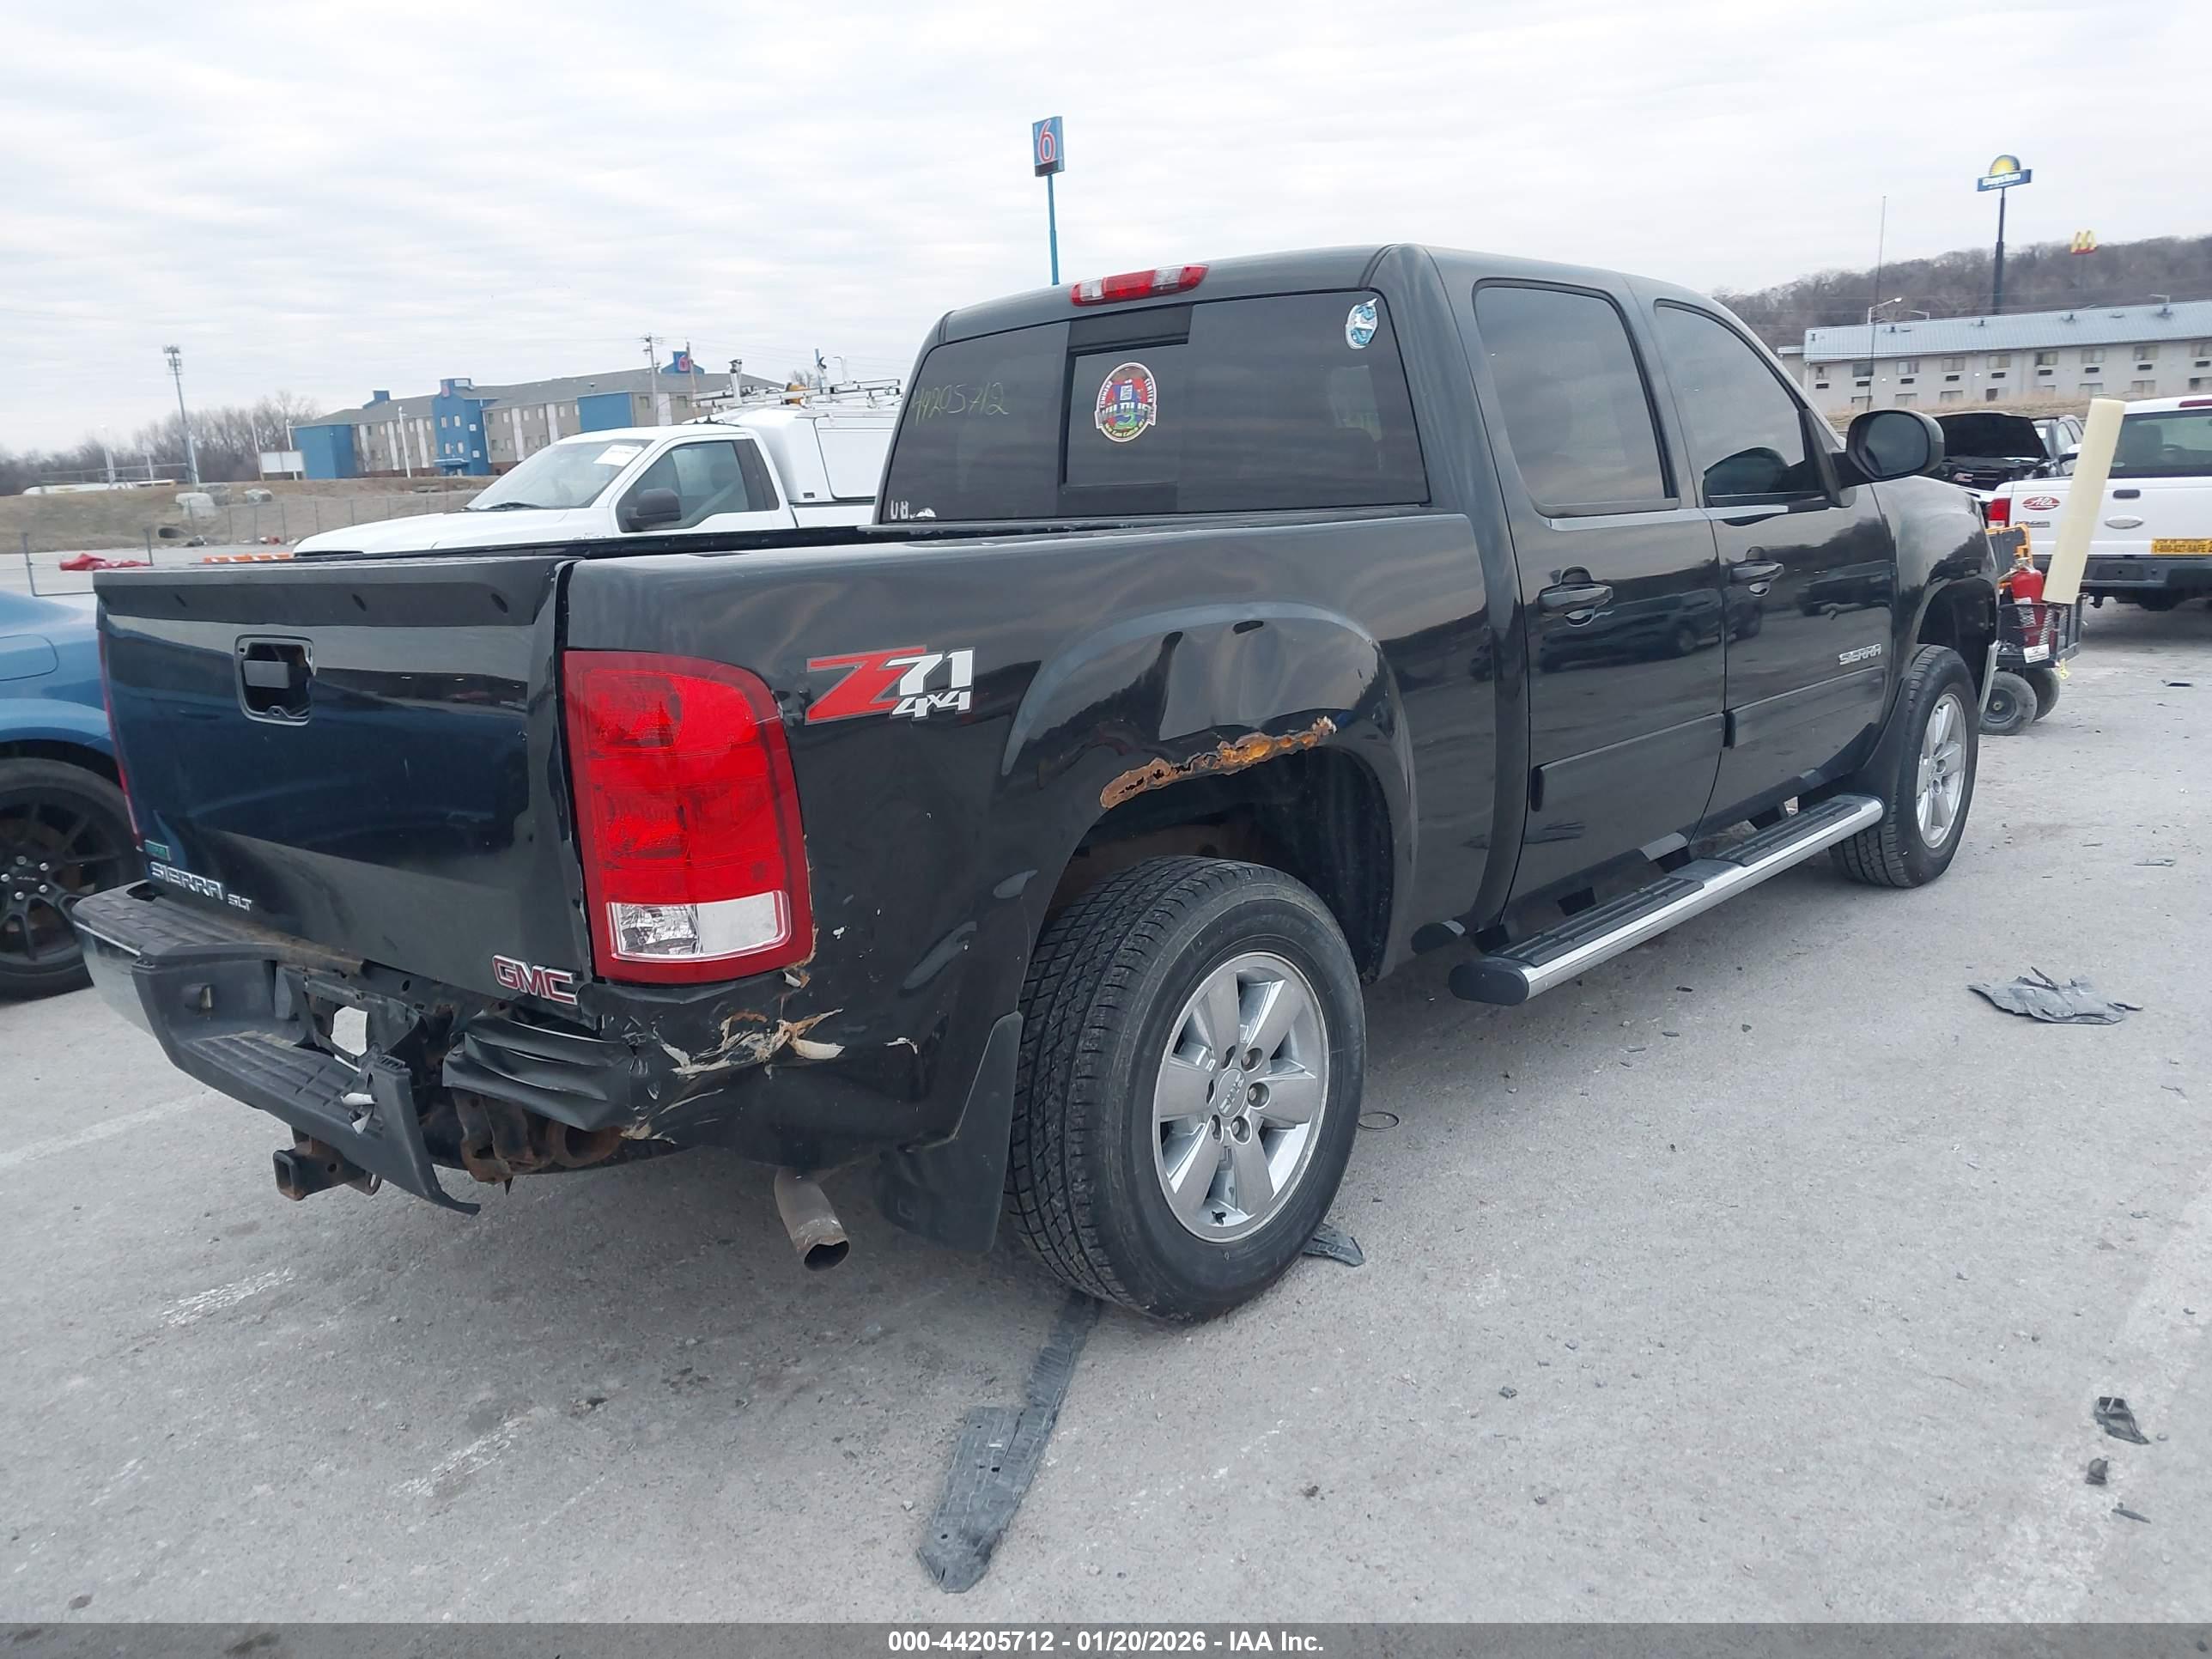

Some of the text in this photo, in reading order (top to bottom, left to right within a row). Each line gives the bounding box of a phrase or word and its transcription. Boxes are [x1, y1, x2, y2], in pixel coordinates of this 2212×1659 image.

[1037, 119, 1056, 163] 6
[1838, 643, 1882, 665] SIERRA
[805, 645, 975, 726] Z71
[150, 861, 253, 912] SIERRA SLT
[492, 954, 578, 1006] GMC
